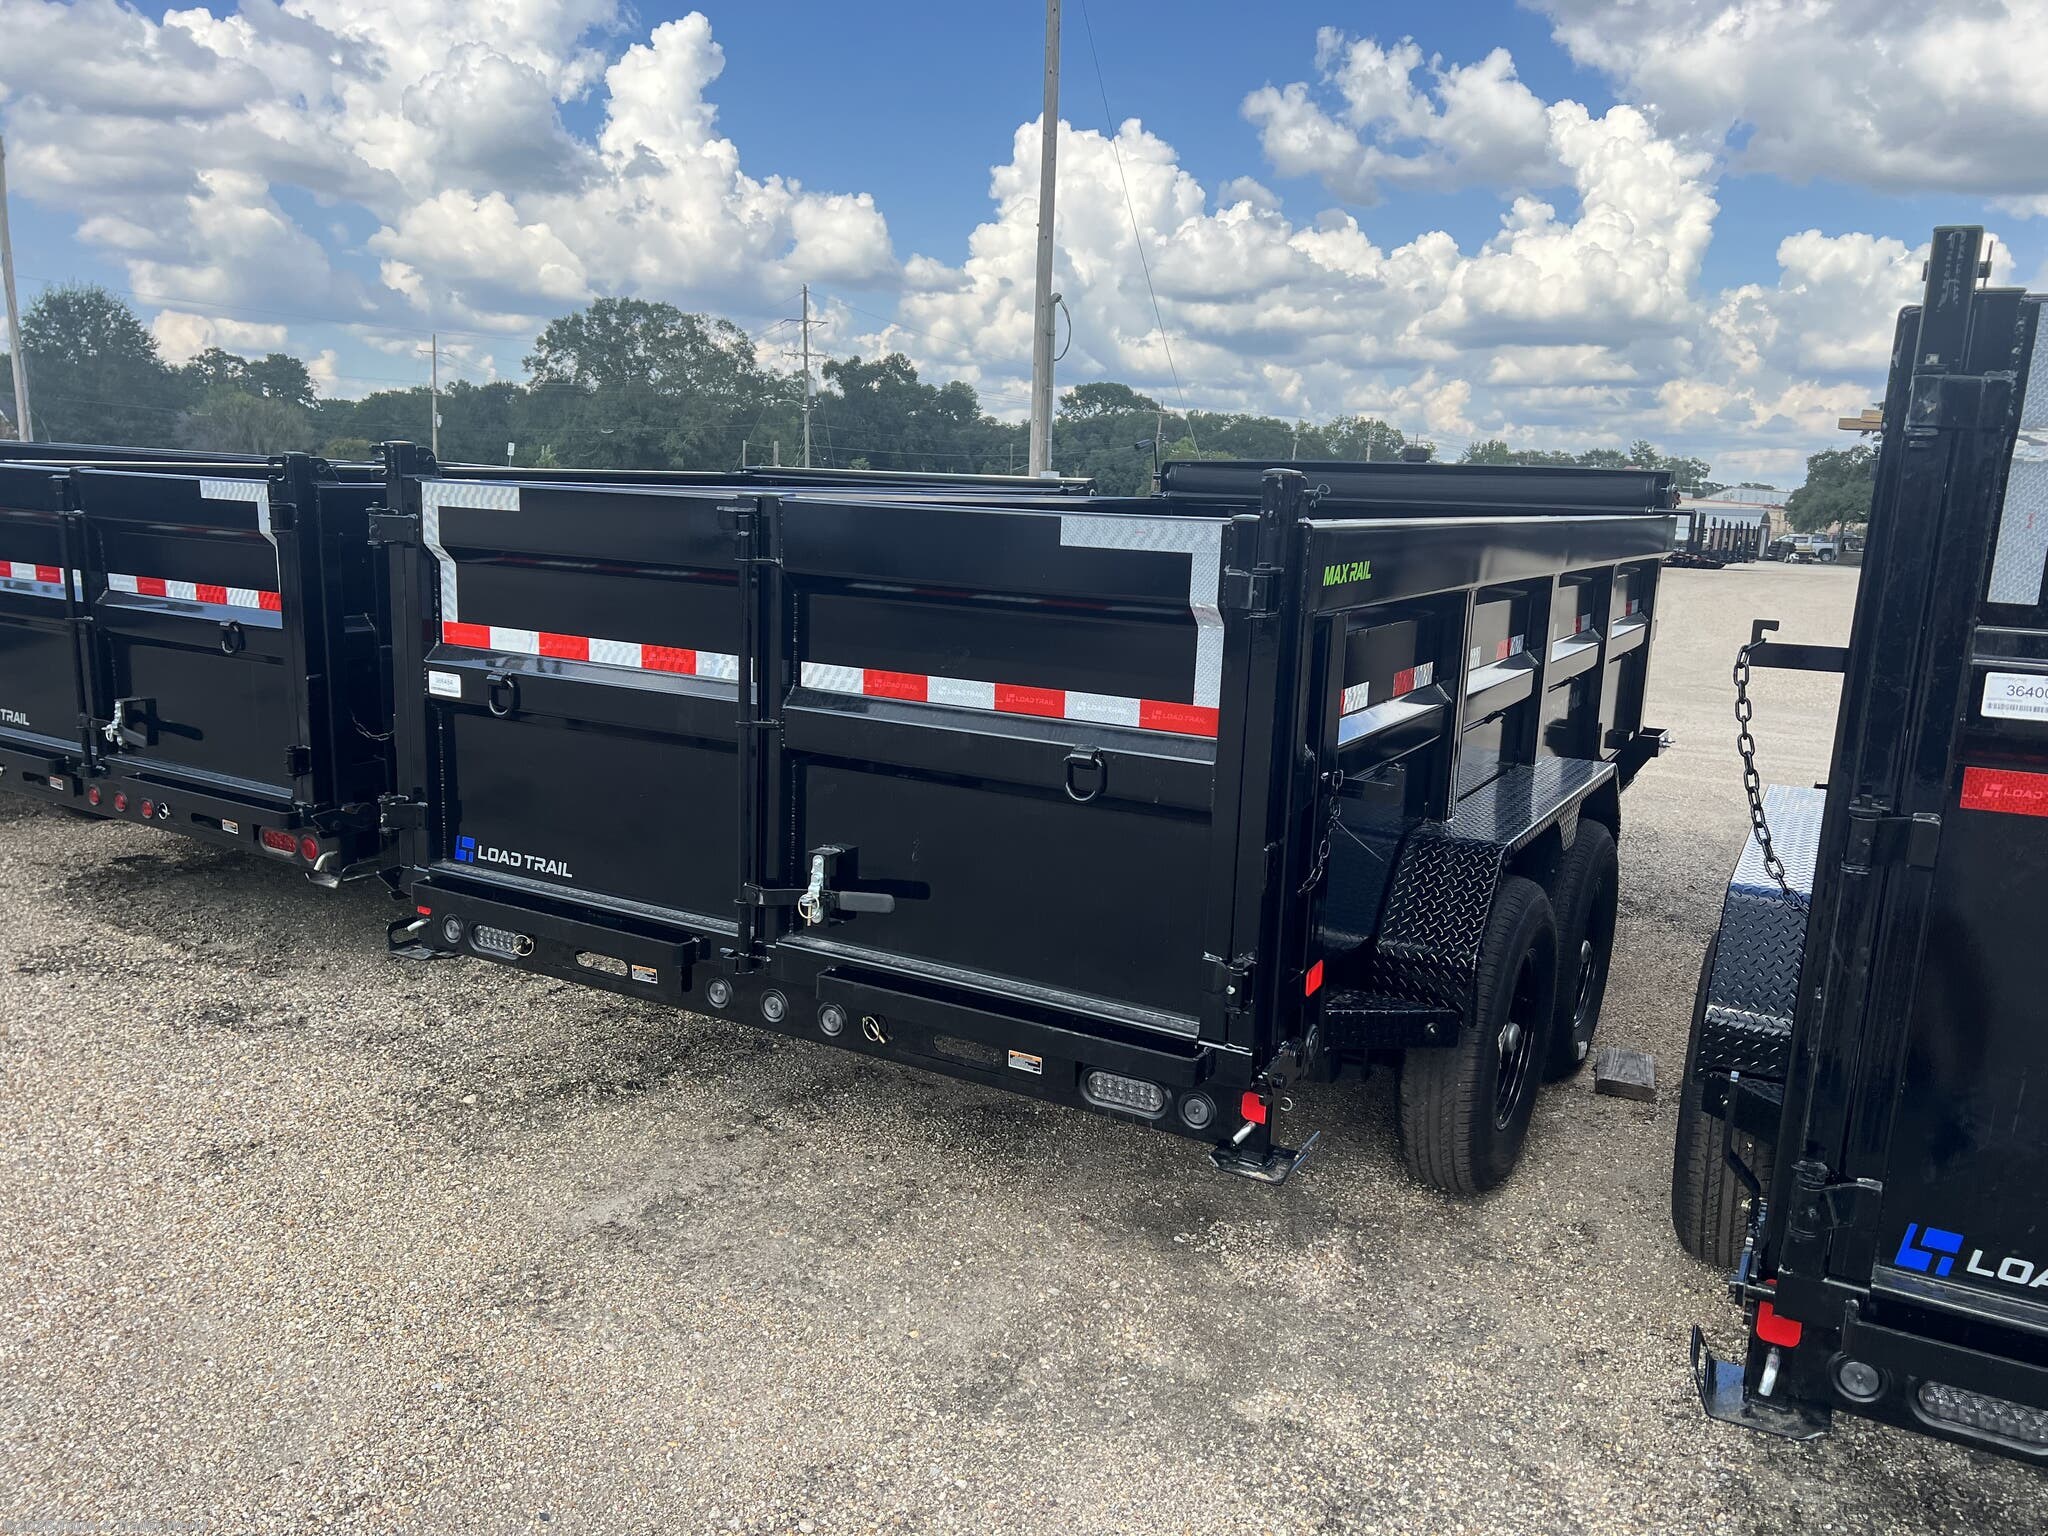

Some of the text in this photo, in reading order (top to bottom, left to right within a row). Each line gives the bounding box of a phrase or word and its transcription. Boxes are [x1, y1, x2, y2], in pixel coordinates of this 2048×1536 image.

[1323, 560, 1372, 587] MAX RAIL
[1015, 696, 1055, 706] LOAD TRAIL
[0, 708, 30, 726] TRAIL
[2003, 787, 2043, 800] LOAD
[477, 844, 573, 878] LOAD TRAIL
